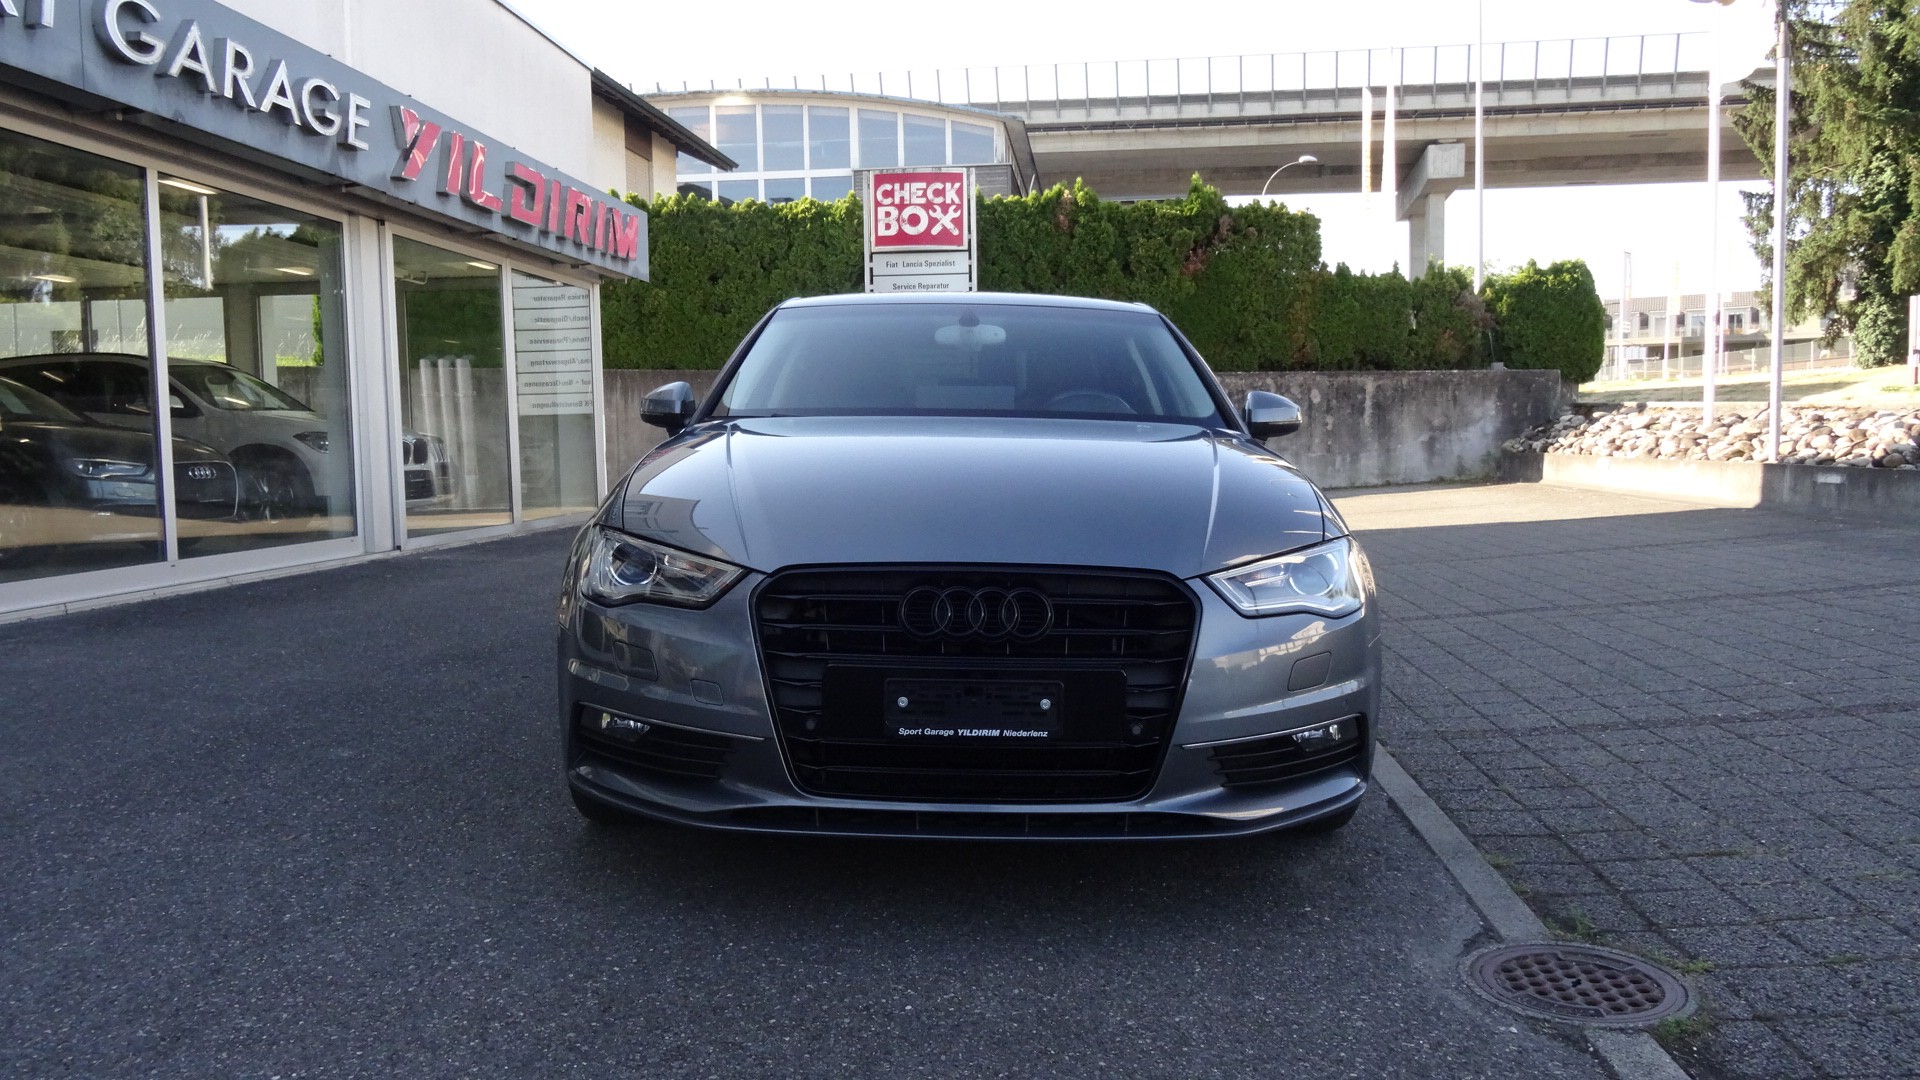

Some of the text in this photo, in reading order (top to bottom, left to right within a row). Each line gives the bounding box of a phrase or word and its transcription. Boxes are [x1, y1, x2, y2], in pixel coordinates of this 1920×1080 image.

[103, 0, 640, 261] GARAGE YILDIRIM
[876, 182, 961, 205] CHECK
[877, 205, 961, 237] BOX
[886, 259, 956, 269] Fiat Lancia Spezialist
[892, 282, 950, 291] Service Reparatur
[898, 727, 1048, 737] Sport Garage YILDIRIM Niederlenz
